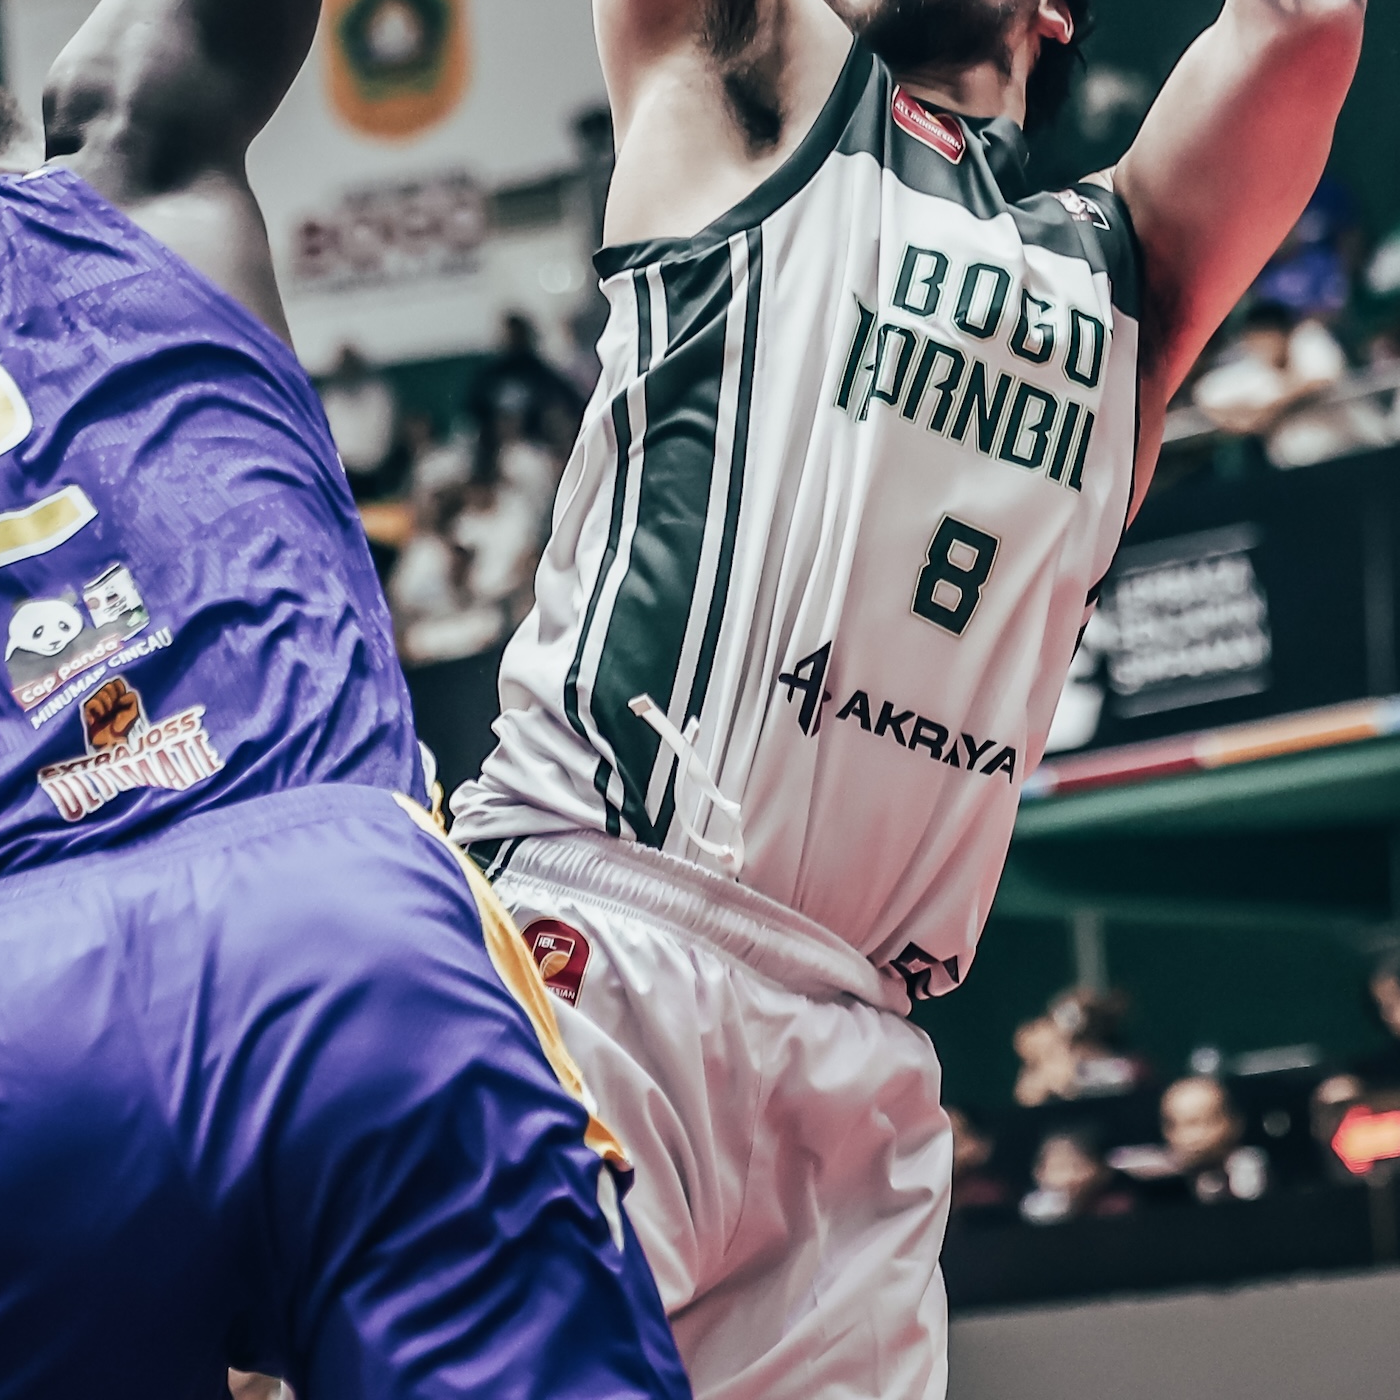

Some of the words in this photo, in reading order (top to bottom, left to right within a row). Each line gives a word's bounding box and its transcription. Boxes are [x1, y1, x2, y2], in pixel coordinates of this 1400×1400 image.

[910, 512, 1002, 637] 8
[107, 625, 174, 669] CINCAU
[21, 676, 57, 705] cap
[58, 637, 121, 682] panda
[137, 712, 197, 751] JOSS
[538, 936, 557, 950] IBL
